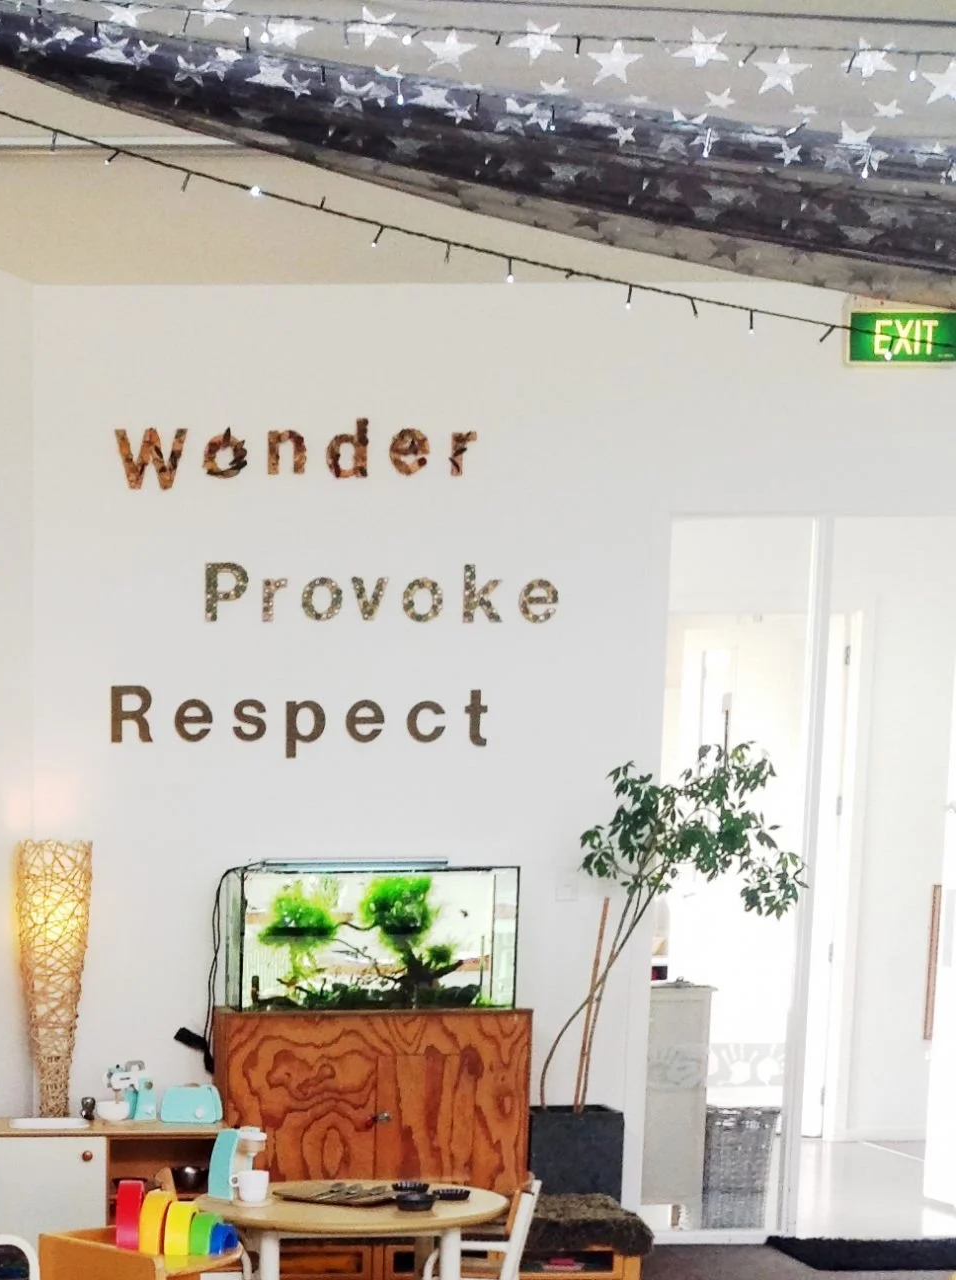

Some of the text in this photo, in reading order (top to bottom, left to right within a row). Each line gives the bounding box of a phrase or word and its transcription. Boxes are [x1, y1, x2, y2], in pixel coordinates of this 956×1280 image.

[873, 318, 939, 356] EXIT
[114, 417, 477, 491] Wonder
[204, 561, 559, 624] Provoke
[110, 684, 488, 759] Respect
